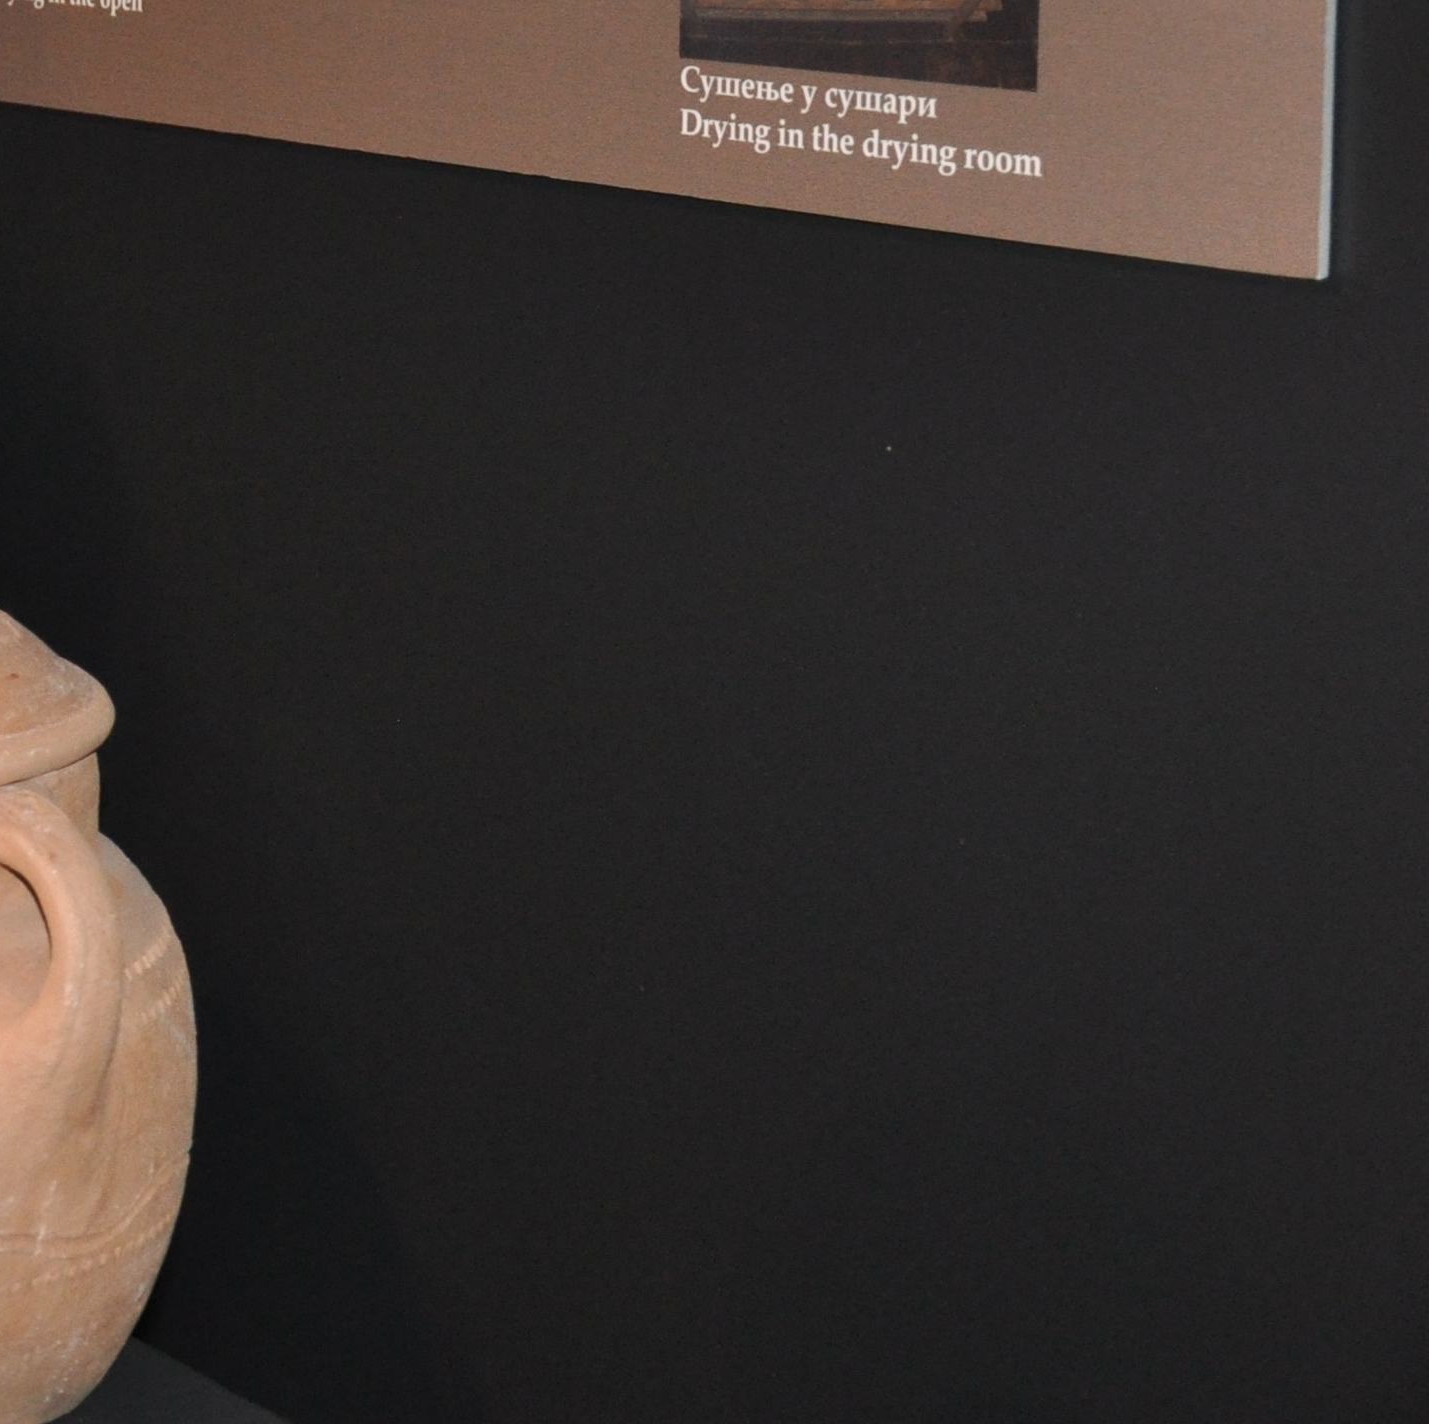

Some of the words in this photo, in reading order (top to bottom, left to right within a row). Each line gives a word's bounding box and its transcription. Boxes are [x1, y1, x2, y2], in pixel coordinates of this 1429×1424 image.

[680, 65, 794, 103] Сушење
[800, 83, 818, 114] у
[824, 87, 938, 124] сушари
[680, 108, 772, 154] Drying
[777, 118, 805, 151] in
[812, 123, 855, 155] the
[862, 129, 957, 177] drying
[963, 146, 1043, 178] room
